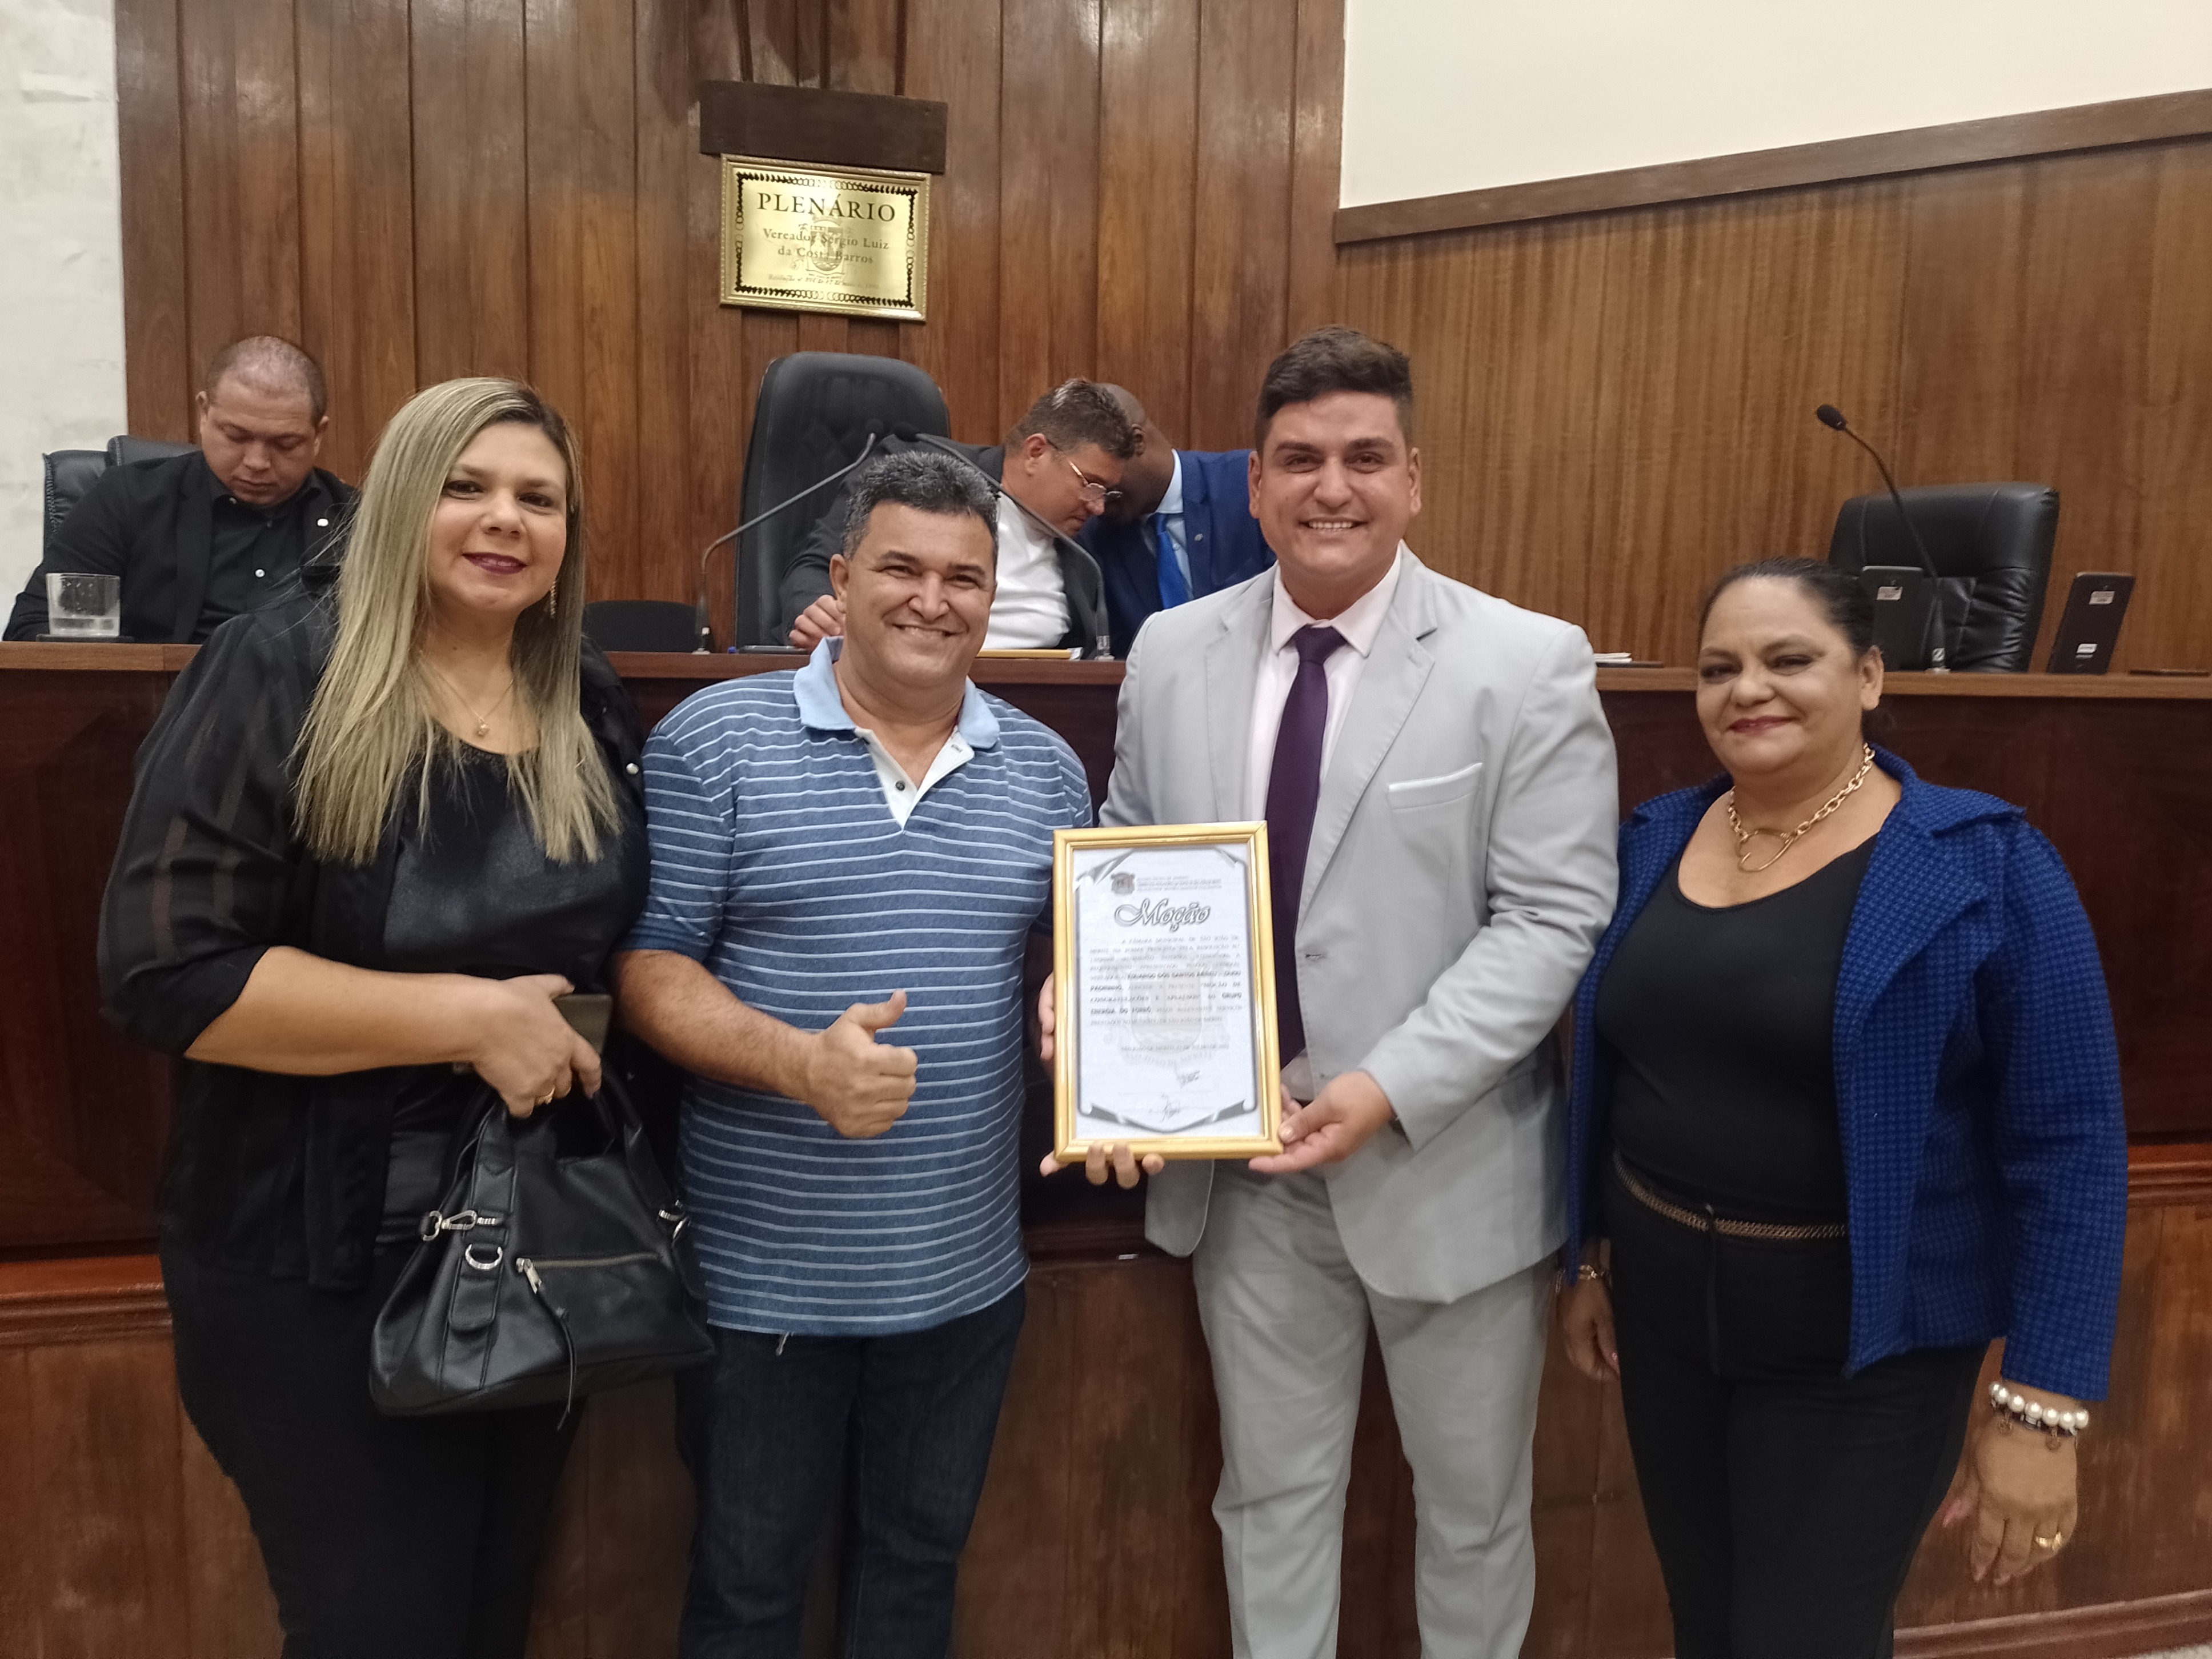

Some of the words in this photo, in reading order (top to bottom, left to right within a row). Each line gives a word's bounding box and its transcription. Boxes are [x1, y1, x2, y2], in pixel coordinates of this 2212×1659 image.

[757, 192, 895, 222] PLENÁRIO
[763, 228, 816, 243] Vereador
[863, 237, 889, 249] Luiz
[778, 246, 792, 256] da
[796, 247, 829, 259] Costa
[835, 250, 874, 263] Barros
[1114, 897, 1211, 932] Moção
